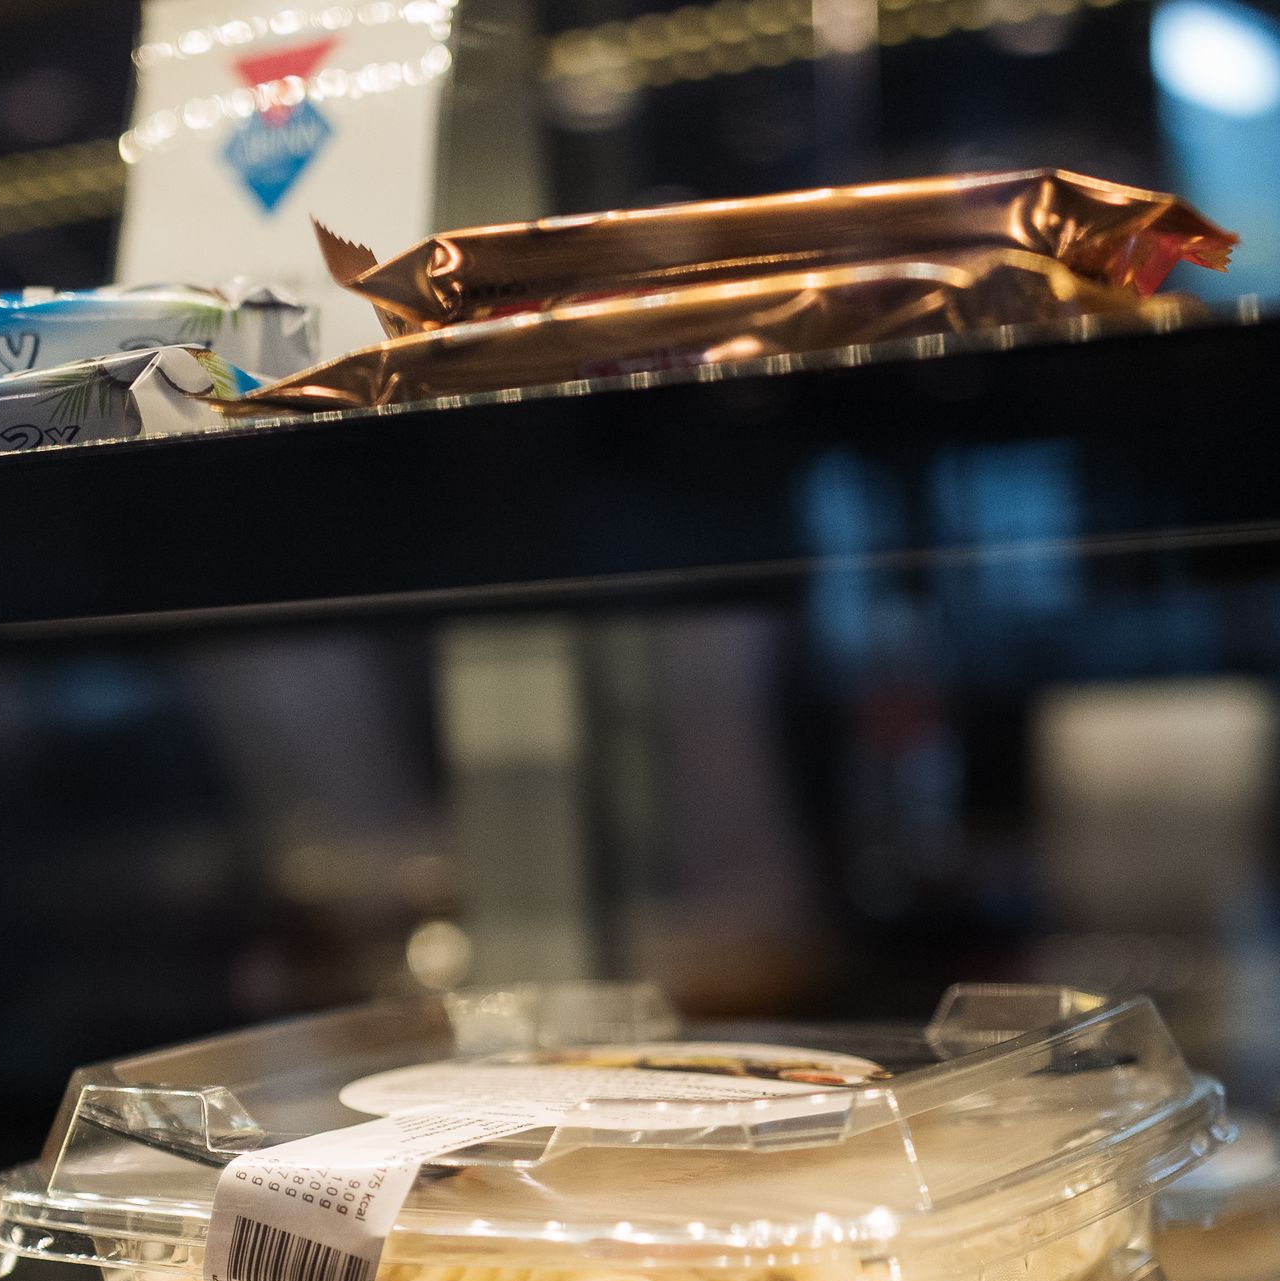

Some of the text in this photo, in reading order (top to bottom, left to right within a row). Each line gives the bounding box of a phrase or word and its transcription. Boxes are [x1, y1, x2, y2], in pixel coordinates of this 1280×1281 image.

[251, 1175, 264, 1186] g
[268, 1181, 280, 1192] g
[285, 1187, 297, 1198] g
[302, 1192, 314, 1204] g
[319, 1198, 332, 1210] g
[336, 1203, 348, 1216] g
[355, 1192, 376, 1222] kcal
